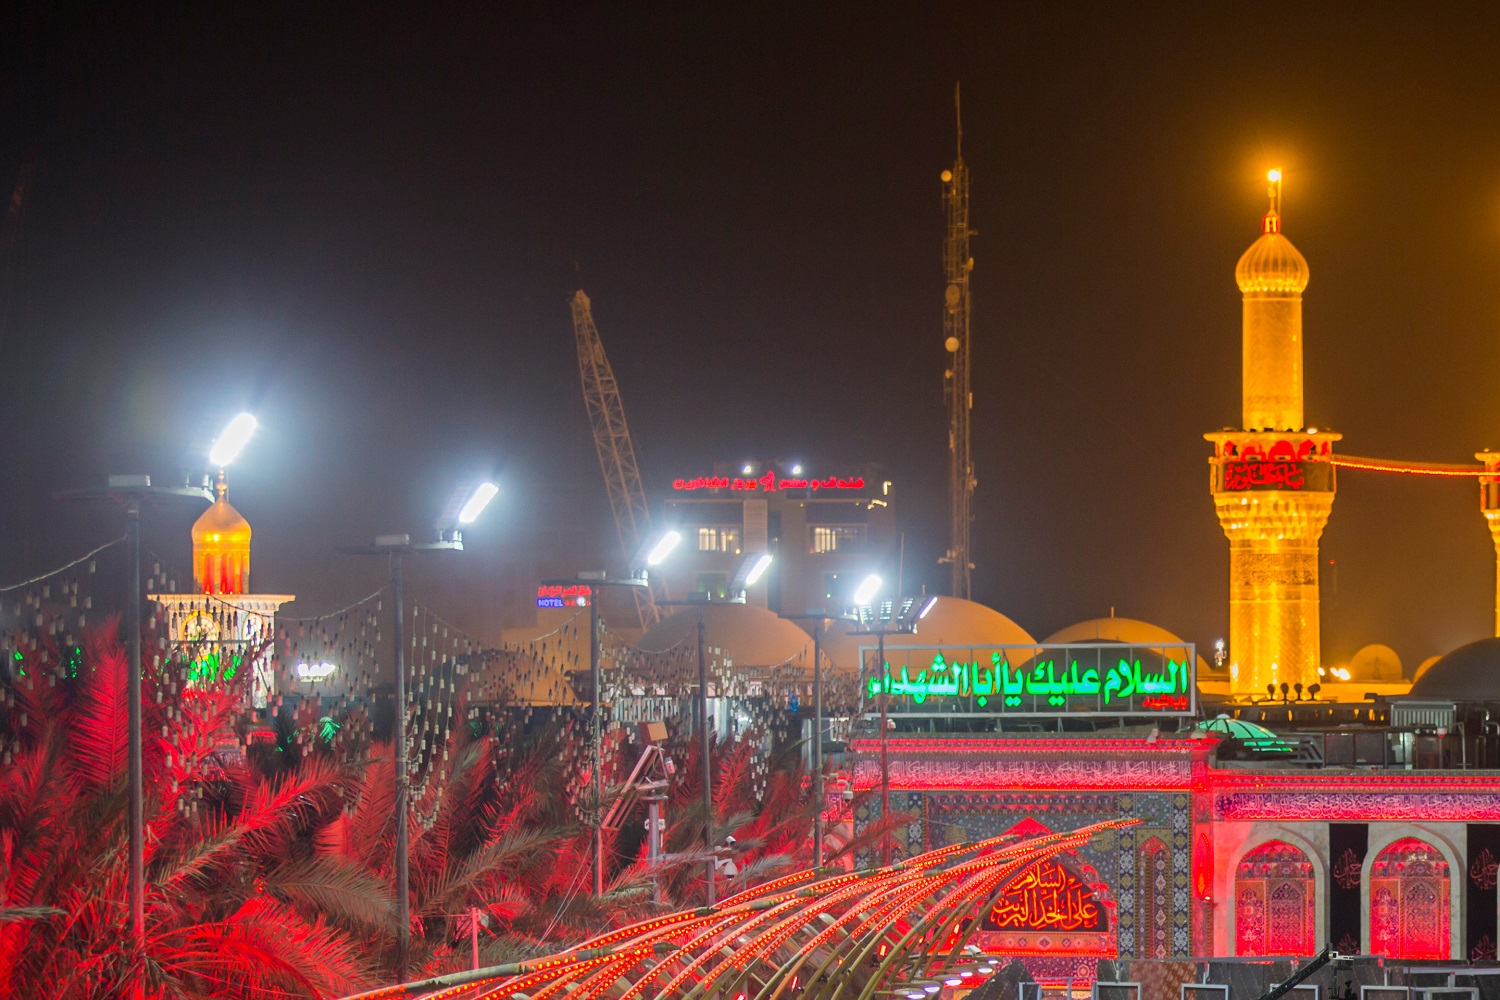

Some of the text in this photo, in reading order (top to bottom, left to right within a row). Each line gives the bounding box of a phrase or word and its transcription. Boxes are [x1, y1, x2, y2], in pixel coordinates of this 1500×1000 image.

[820, 476, 865, 490] فندق
[537, 598, 564, 608] HOTEL
[867, 653, 970, 705] الشهداء
[1026, 659, 1102, 707] عليك
[1104, 658, 1188, 704] السلام
[1010, 862, 1067, 894] السلام
